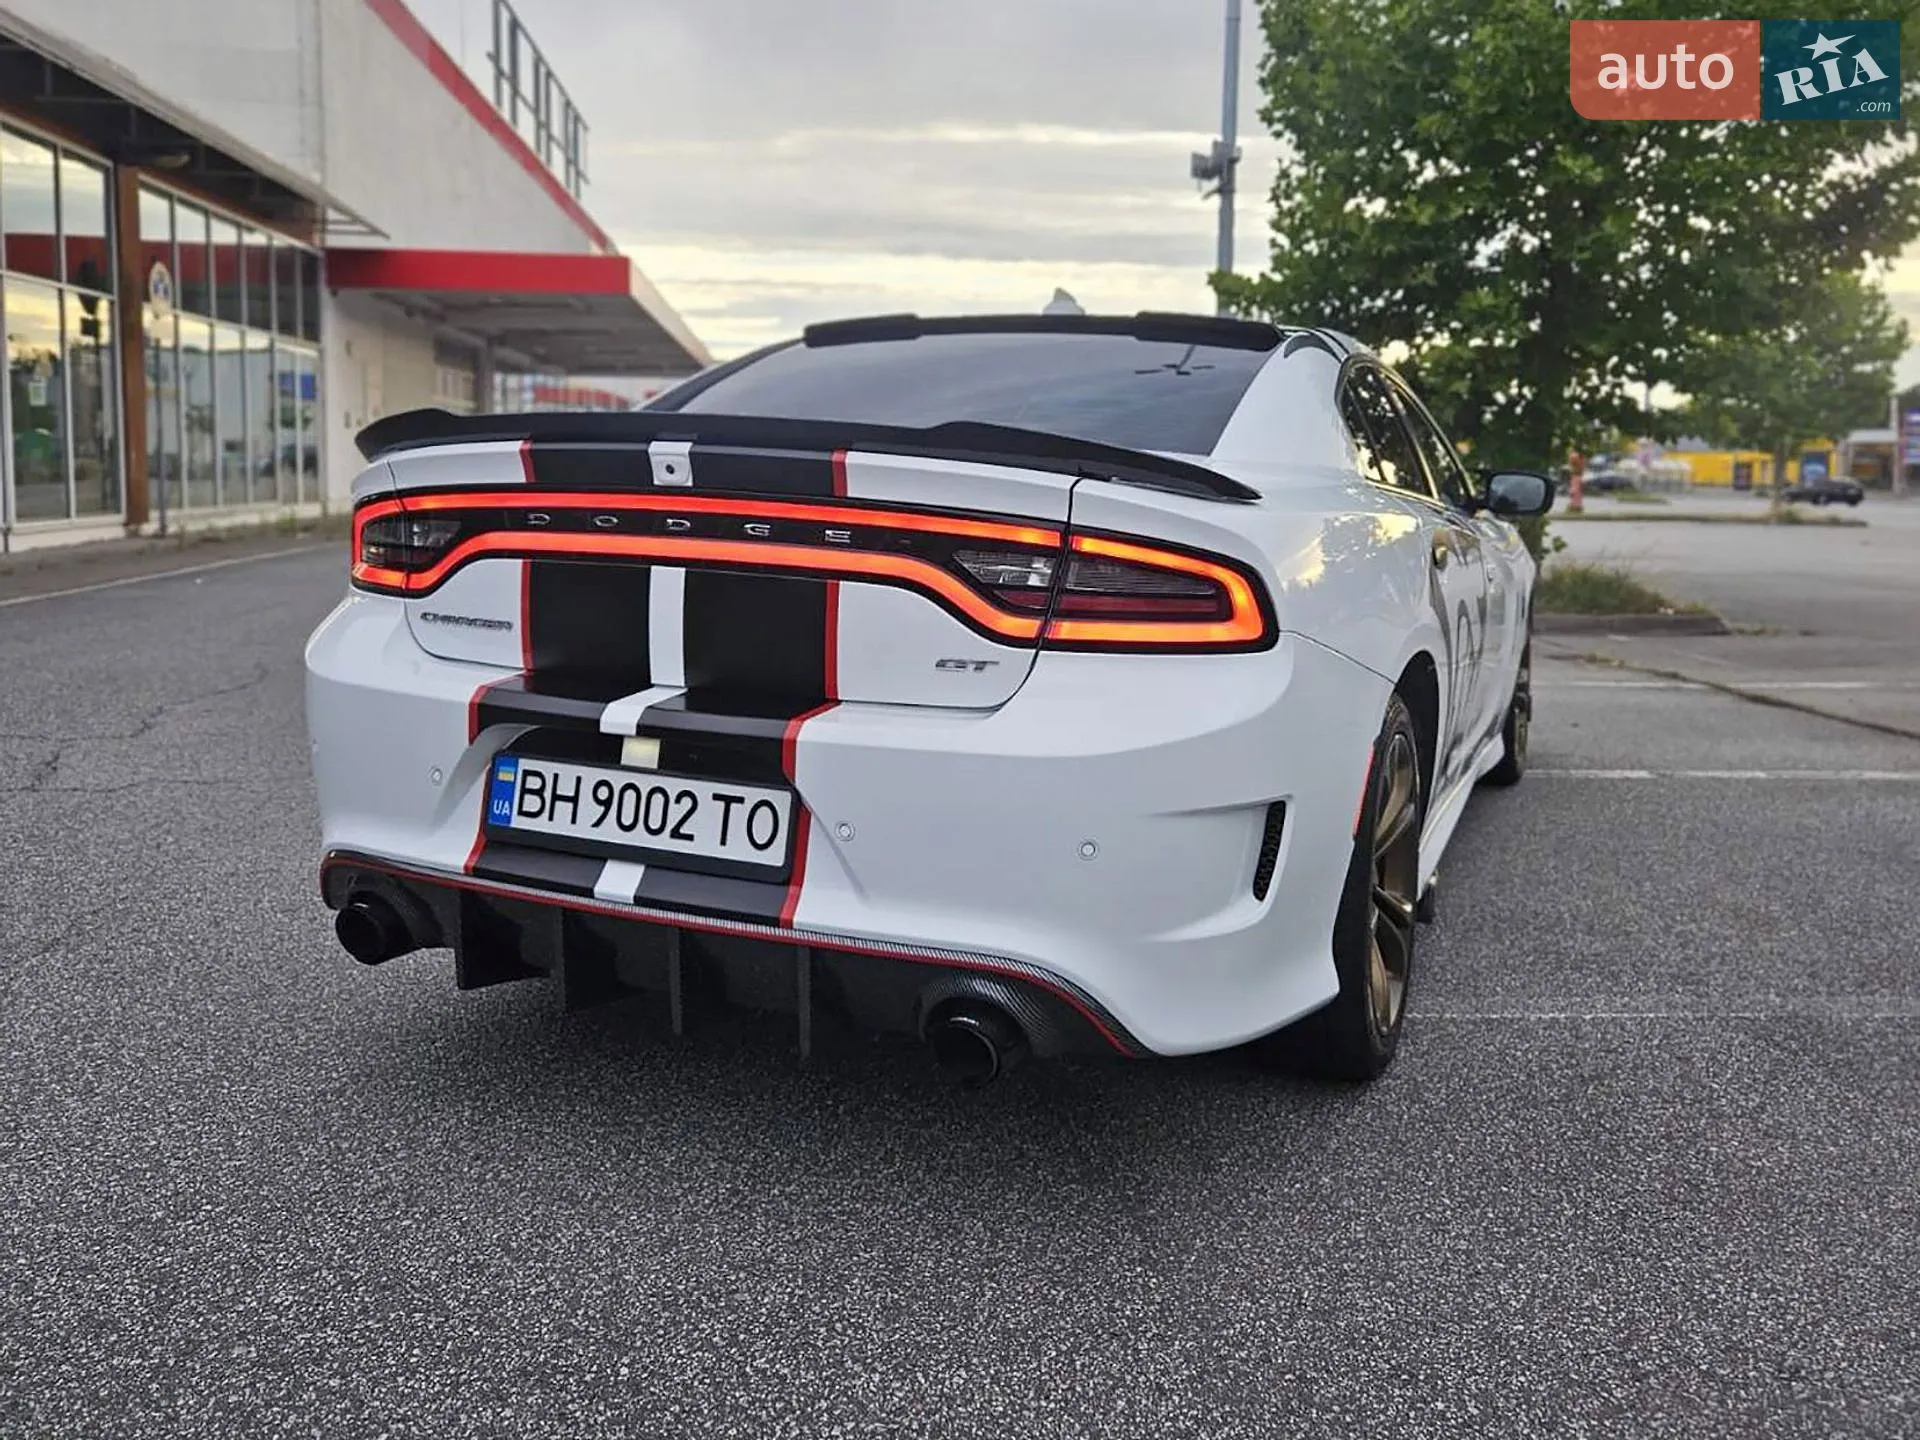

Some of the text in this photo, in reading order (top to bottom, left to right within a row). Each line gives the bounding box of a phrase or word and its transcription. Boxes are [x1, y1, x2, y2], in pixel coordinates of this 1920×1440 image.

[527, 512, 851, 543] DODGE
[935, 658, 999, 673] GT
[493, 800, 511, 817] UA
[516, 768, 780, 851] BH 9002 TO
